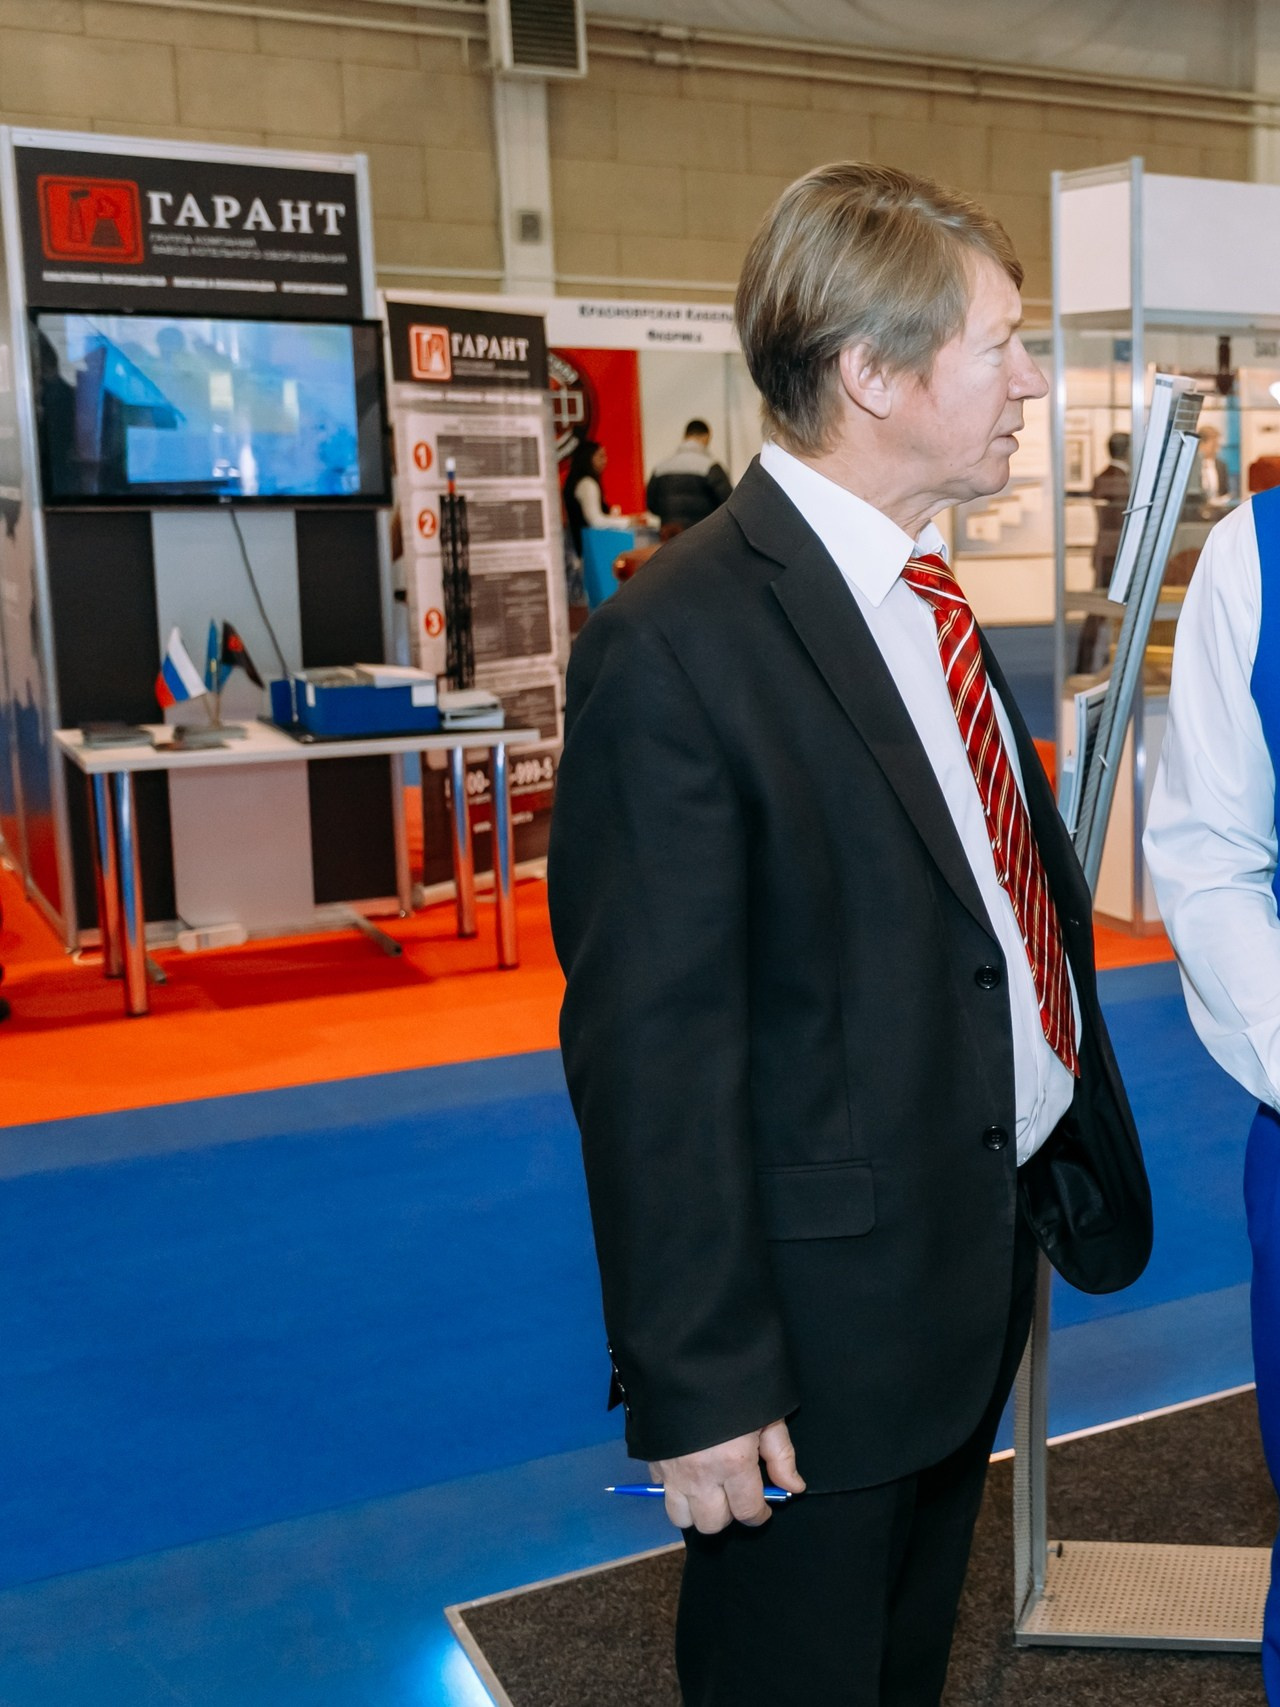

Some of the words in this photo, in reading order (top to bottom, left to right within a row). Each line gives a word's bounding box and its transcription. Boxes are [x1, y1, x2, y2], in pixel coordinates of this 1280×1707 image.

[147, 191, 345, 235] ГАРАНТ
[451, 332, 529, 361] ГАРАНТ
[416, 445, 429, 466] 1
[420, 510, 434, 530] 2
[428, 611, 440, 635] 3
